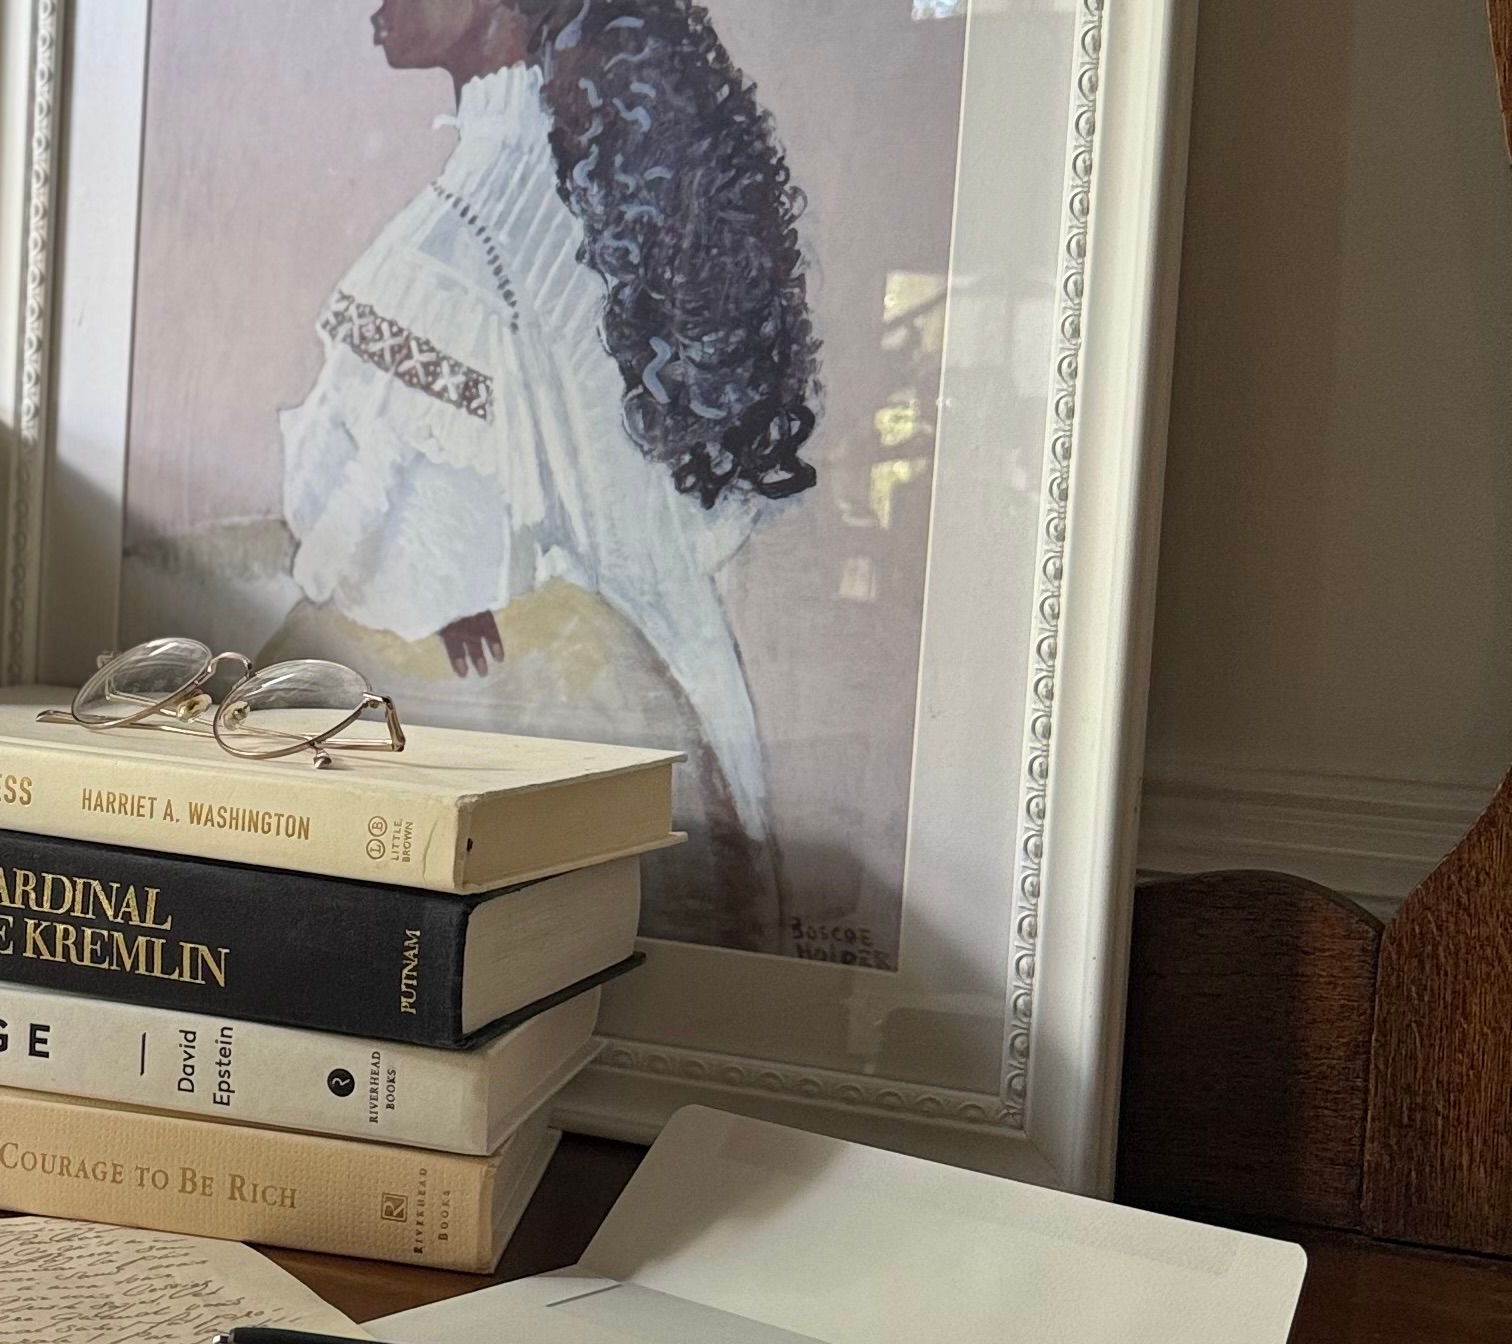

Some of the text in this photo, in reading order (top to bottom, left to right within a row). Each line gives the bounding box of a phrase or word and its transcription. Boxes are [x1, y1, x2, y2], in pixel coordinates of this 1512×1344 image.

[81, 788, 157, 819] HARRIET
[163, 799, 180, 822] A.
[188, 801, 311, 840] WASHINGTON
[402, 821, 414, 863] BROWN
[22, 915, 231, 988] KREMLIN
[400, 927, 422, 1016] PUTNAM
[177, 1028, 198, 1094] David
[213, 1025, 234, 1107] Epstein
[369, 1050, 381, 1124] RIVERHEAD
[386, 1068, 397, 1110] BOOKS
[135, 1164, 169, 1191] TO
[179, 1167, 214, 1196] BE
[229, 1172, 298, 1210] RICH
[413, 1167, 428, 1255] RIVERHEAD
[438, 1190, 451, 1241] BOOKS
